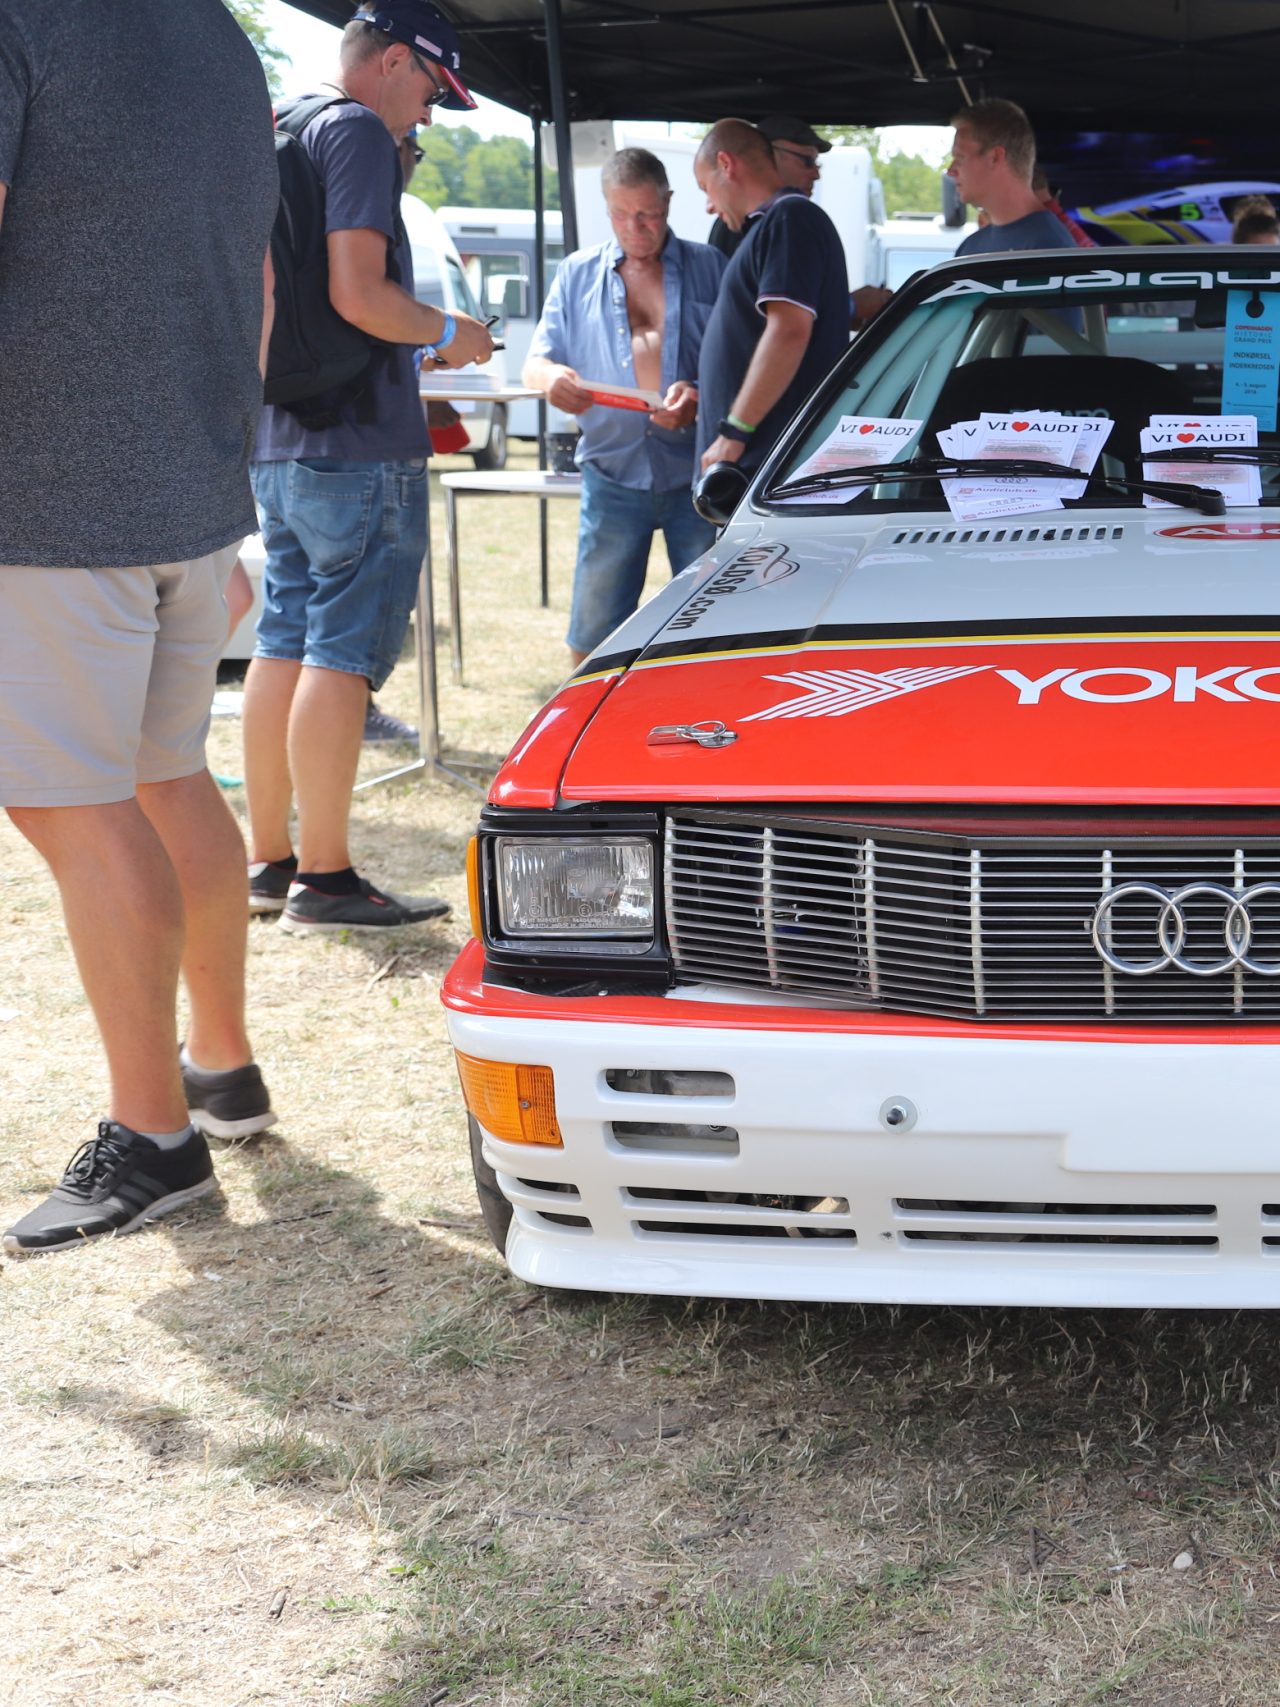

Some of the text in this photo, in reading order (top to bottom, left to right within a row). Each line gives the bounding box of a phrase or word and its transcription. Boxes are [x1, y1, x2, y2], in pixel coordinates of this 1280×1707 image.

[1180, 203, 1200, 221] 5
[919, 270, 1140, 304] Audi
[873, 426, 915, 436] AUDI
[1028, 423, 1079, 433] AUDI
[1195, 433, 1246, 442] AUDI
